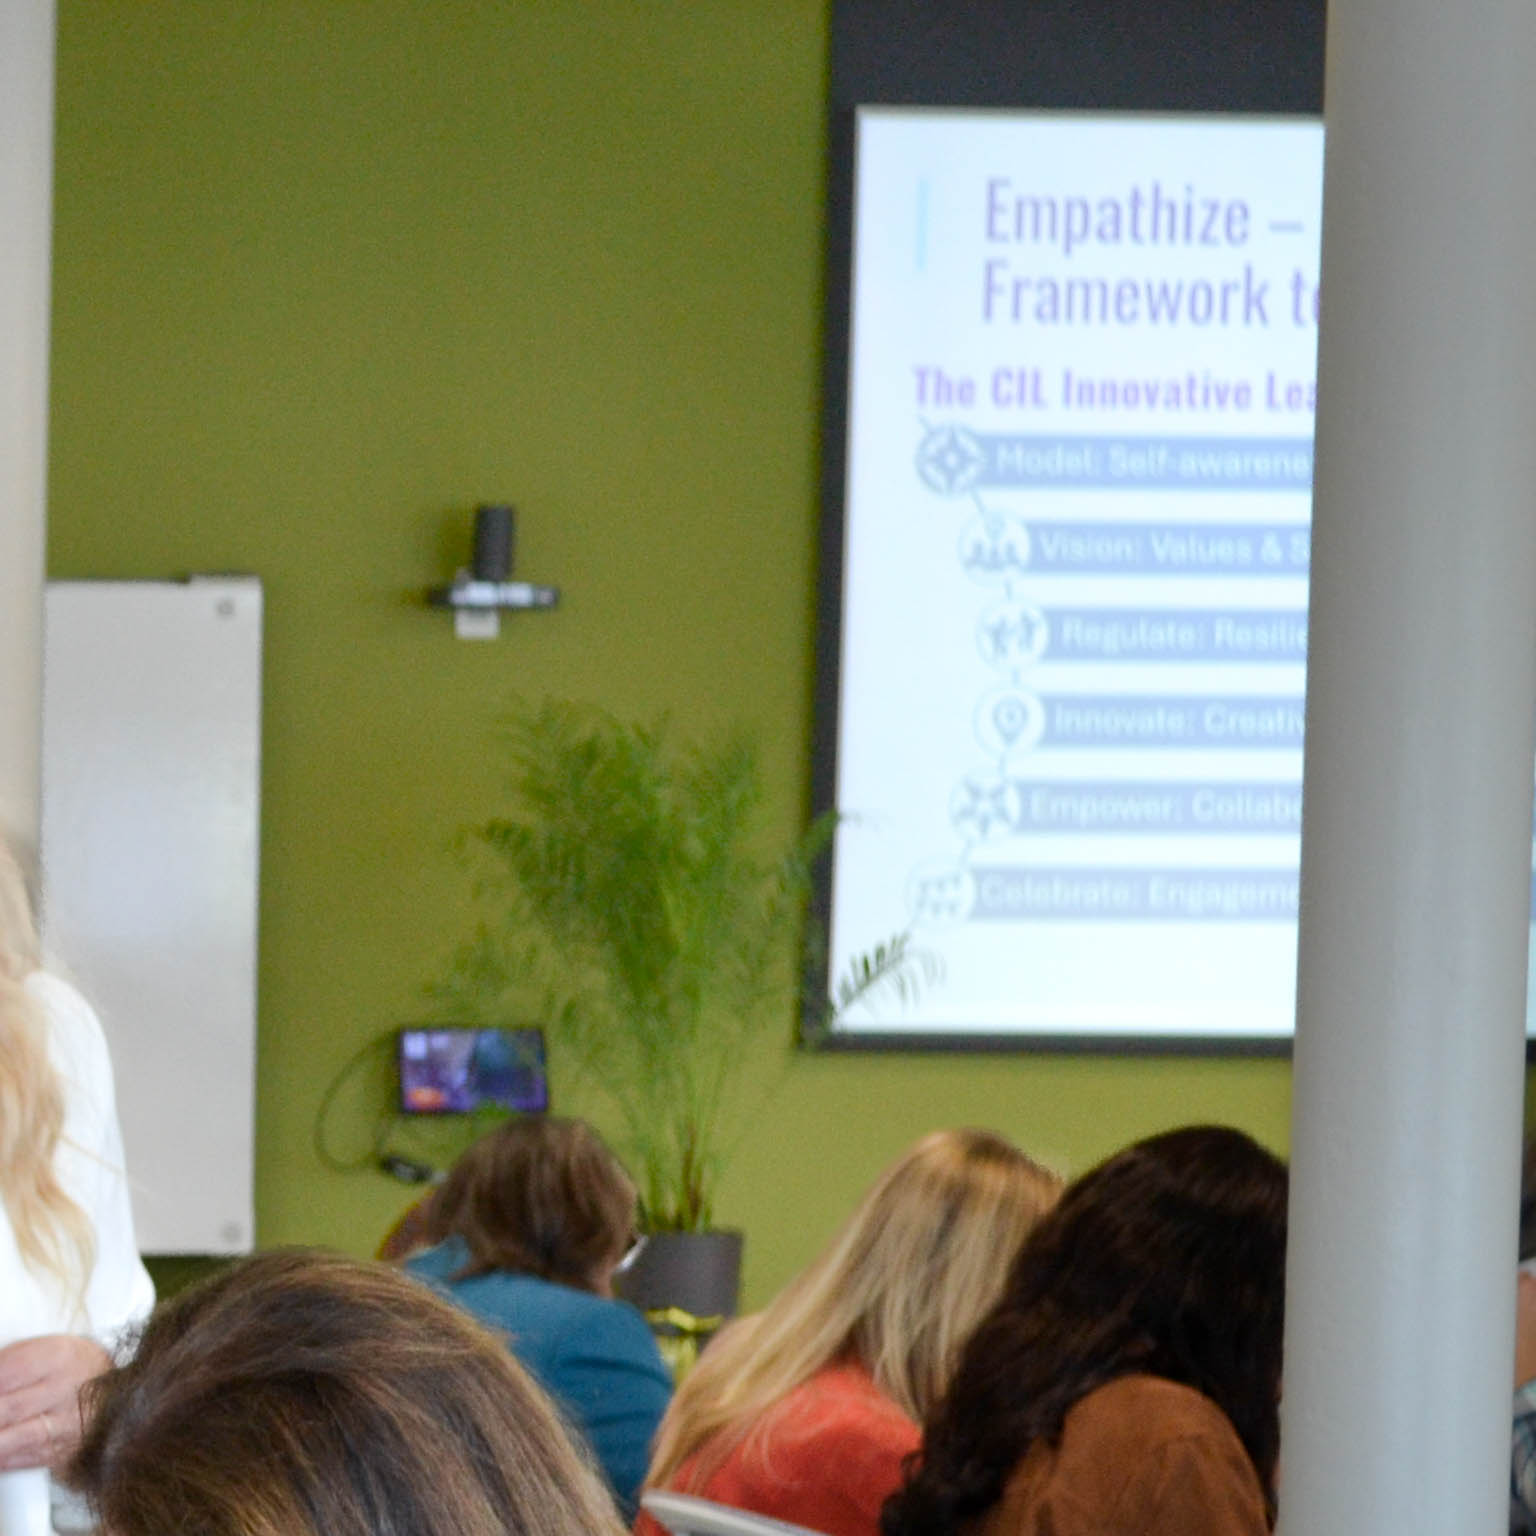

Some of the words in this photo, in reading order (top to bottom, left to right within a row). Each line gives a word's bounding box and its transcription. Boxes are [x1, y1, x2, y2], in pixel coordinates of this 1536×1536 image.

[985, 176, 1251, 258] Empathize
[982, 258, 1271, 327] Framework
[913, 365, 977, 409] The
[990, 366, 1049, 411] CIL
[1062, 367, 1253, 411] Innovative
[996, 444, 1101, 476] Model:
[1039, 530, 1141, 562] Vision:
[1150, 530, 1253, 563] Values
[1062, 617, 1203, 653] Regulate:
[1055, 703, 1194, 737] Innovate:
[1030, 788, 1184, 827] Empower:
